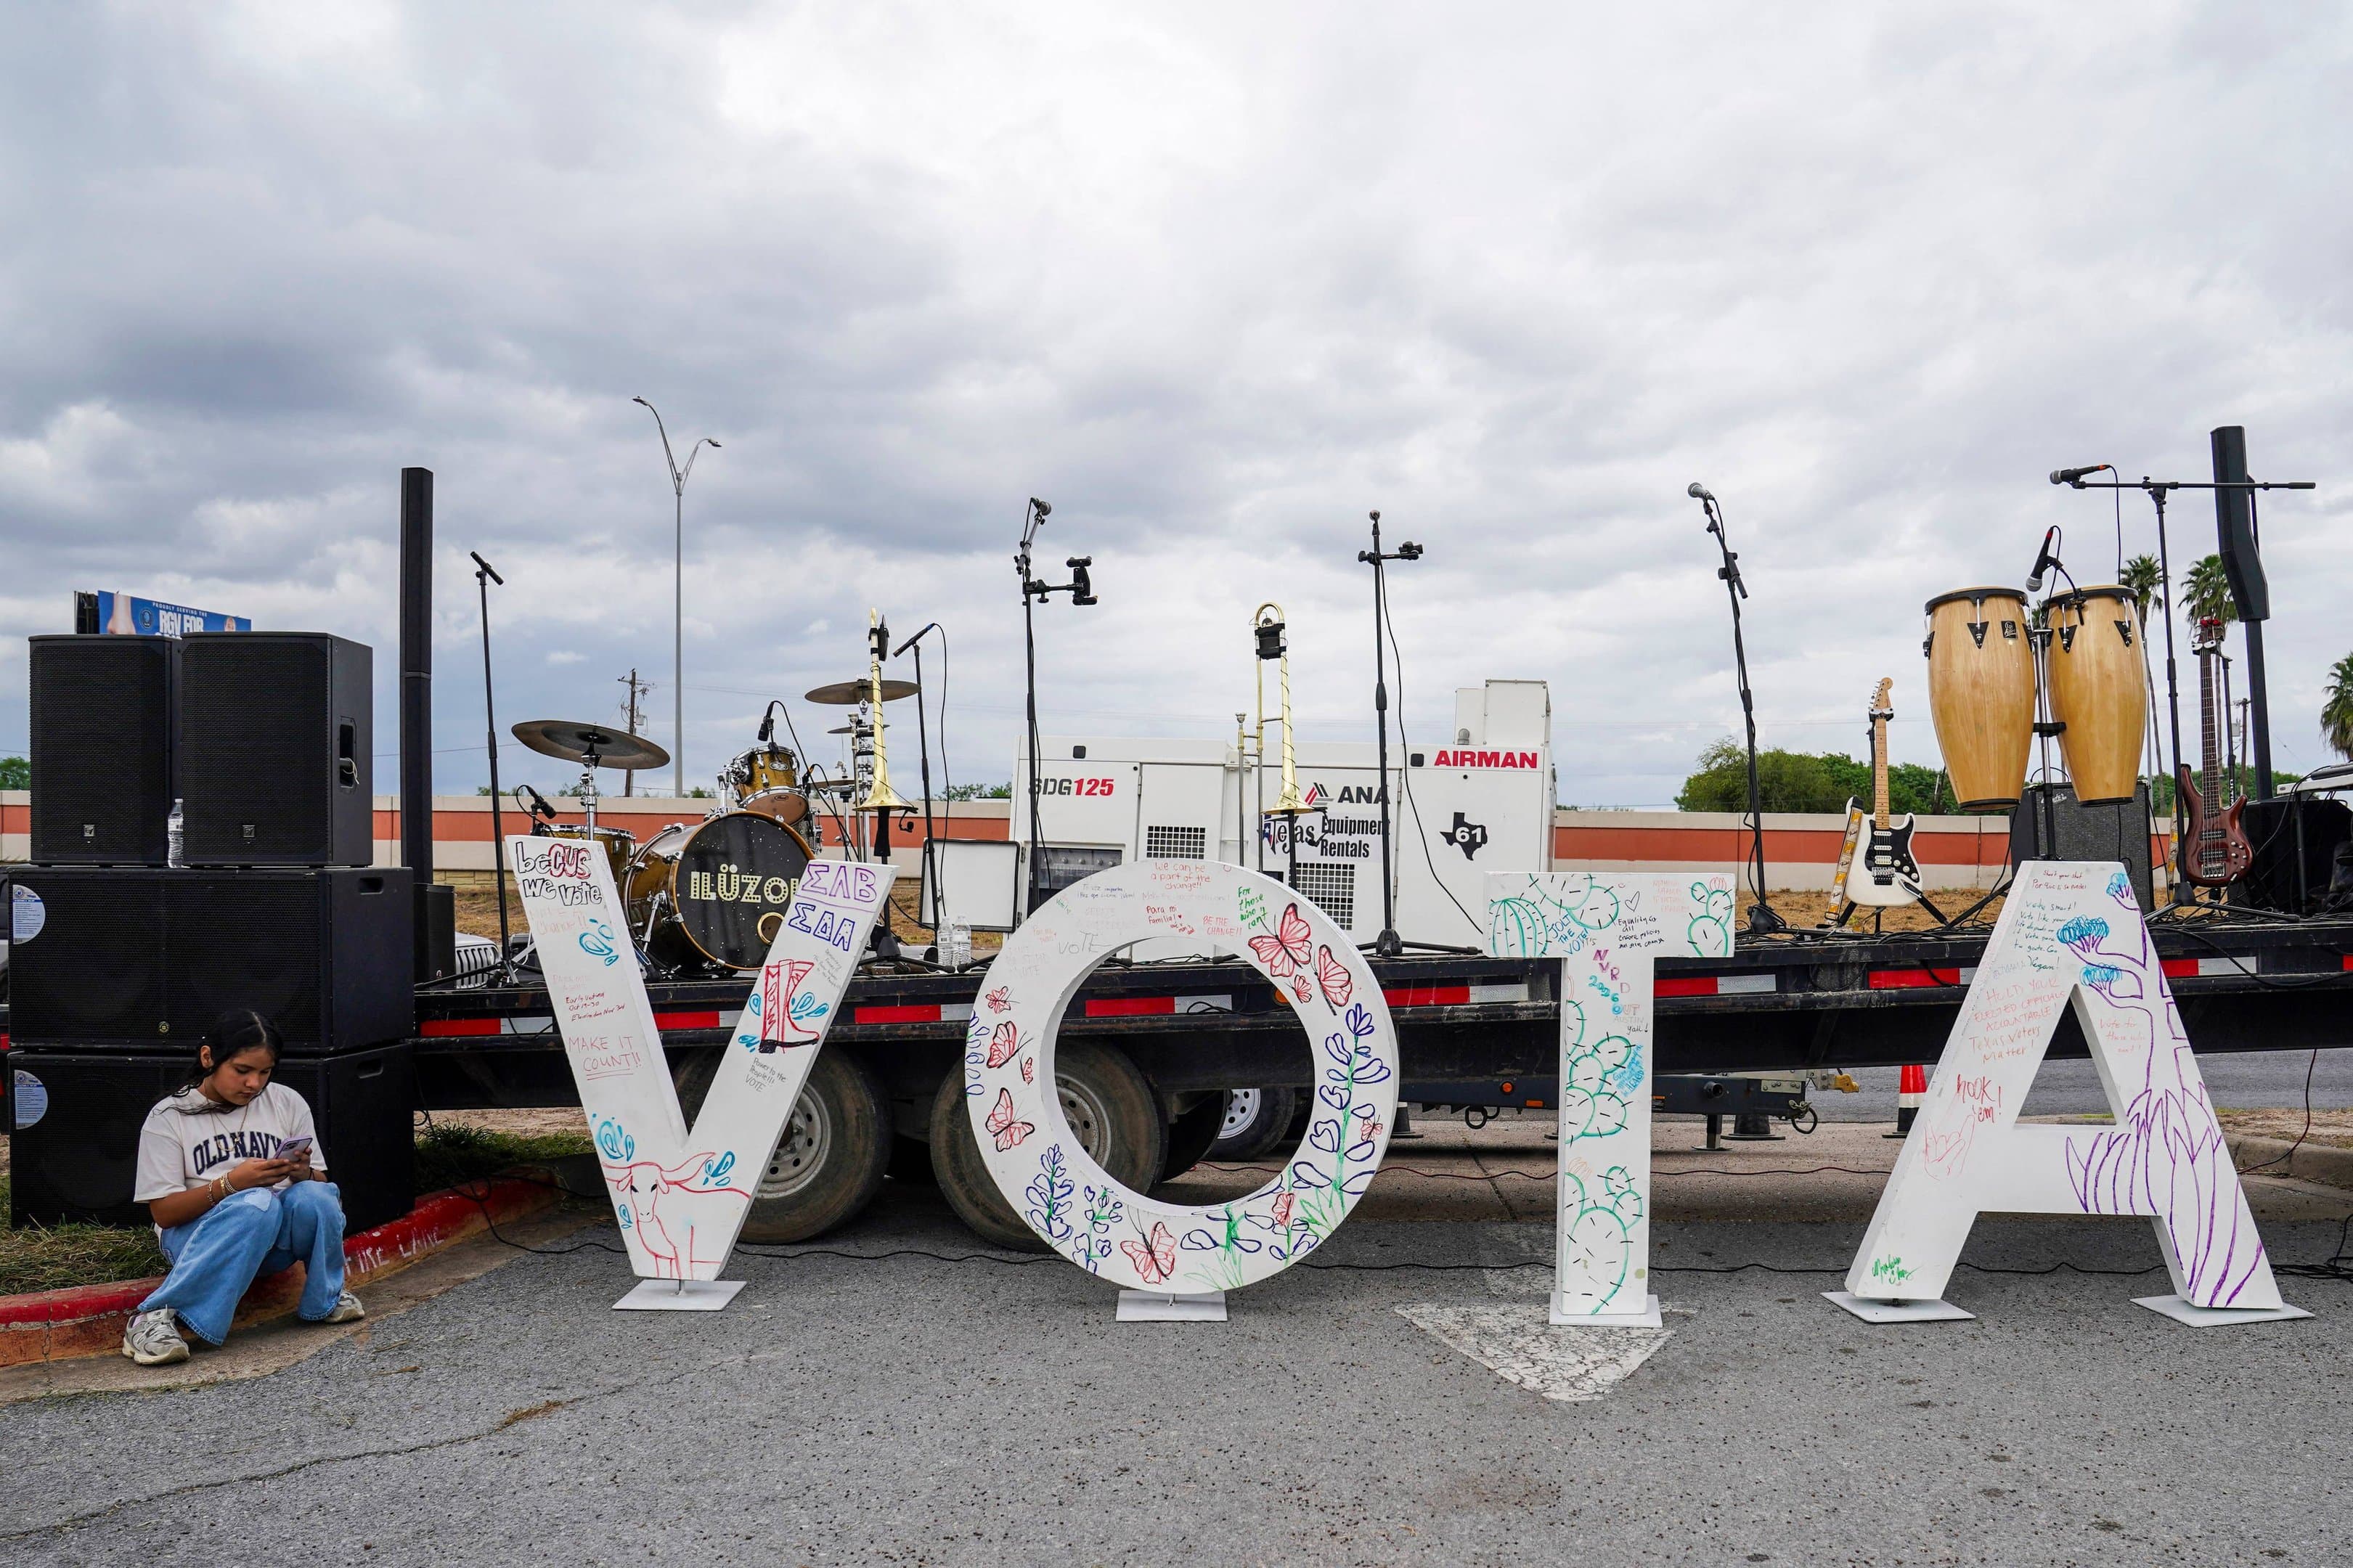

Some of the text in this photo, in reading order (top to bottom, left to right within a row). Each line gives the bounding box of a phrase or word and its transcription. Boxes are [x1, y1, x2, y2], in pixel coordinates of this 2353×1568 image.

[152, 602, 174, 611] PROUDLY
[176, 606, 197, 616] SERVING
[159, 610, 204, 634] RGV FOR
[1434, 750, 1538, 769] AIRMAN
[1264, 815, 1316, 855] Teas
[1455, 826, 1482, 843] 61
[1320, 839, 1370, 858] Rentals
[1155, 862, 1169, 871] We
[1173, 862, 1191, 873] can
[690, 863, 799, 905] ILÜZO
[1159, 872, 1181, 881] part
[1184, 873, 1192, 882] of
[1196, 873, 1212, 883] the
[2033, 878, 2043, 889] Por
[1238, 886, 1251, 897] For
[1146, 905, 1165, 914] Para
[1239, 894, 1265, 911] those
[1202, 915, 1230, 927] BE THE
[1240, 908, 1256, 922] who
[2020, 911, 2034, 920] Vote
[1549, 913, 1573, 939] JOLT
[1057, 930, 1113, 955] VOTE
[1557, 928, 1575, 945] THE
[568, 1035, 634, 1052] MAKE IT
[583, 1052, 642, 1072] COUNT!!
[754, 1057, 770, 1071] Power
[777, 1072, 787, 1083] the
[745, 1074, 767, 1093] VOTE
[192, 1131, 283, 1175] OLD NAVY
[398, 1226, 446, 1258] LANE
